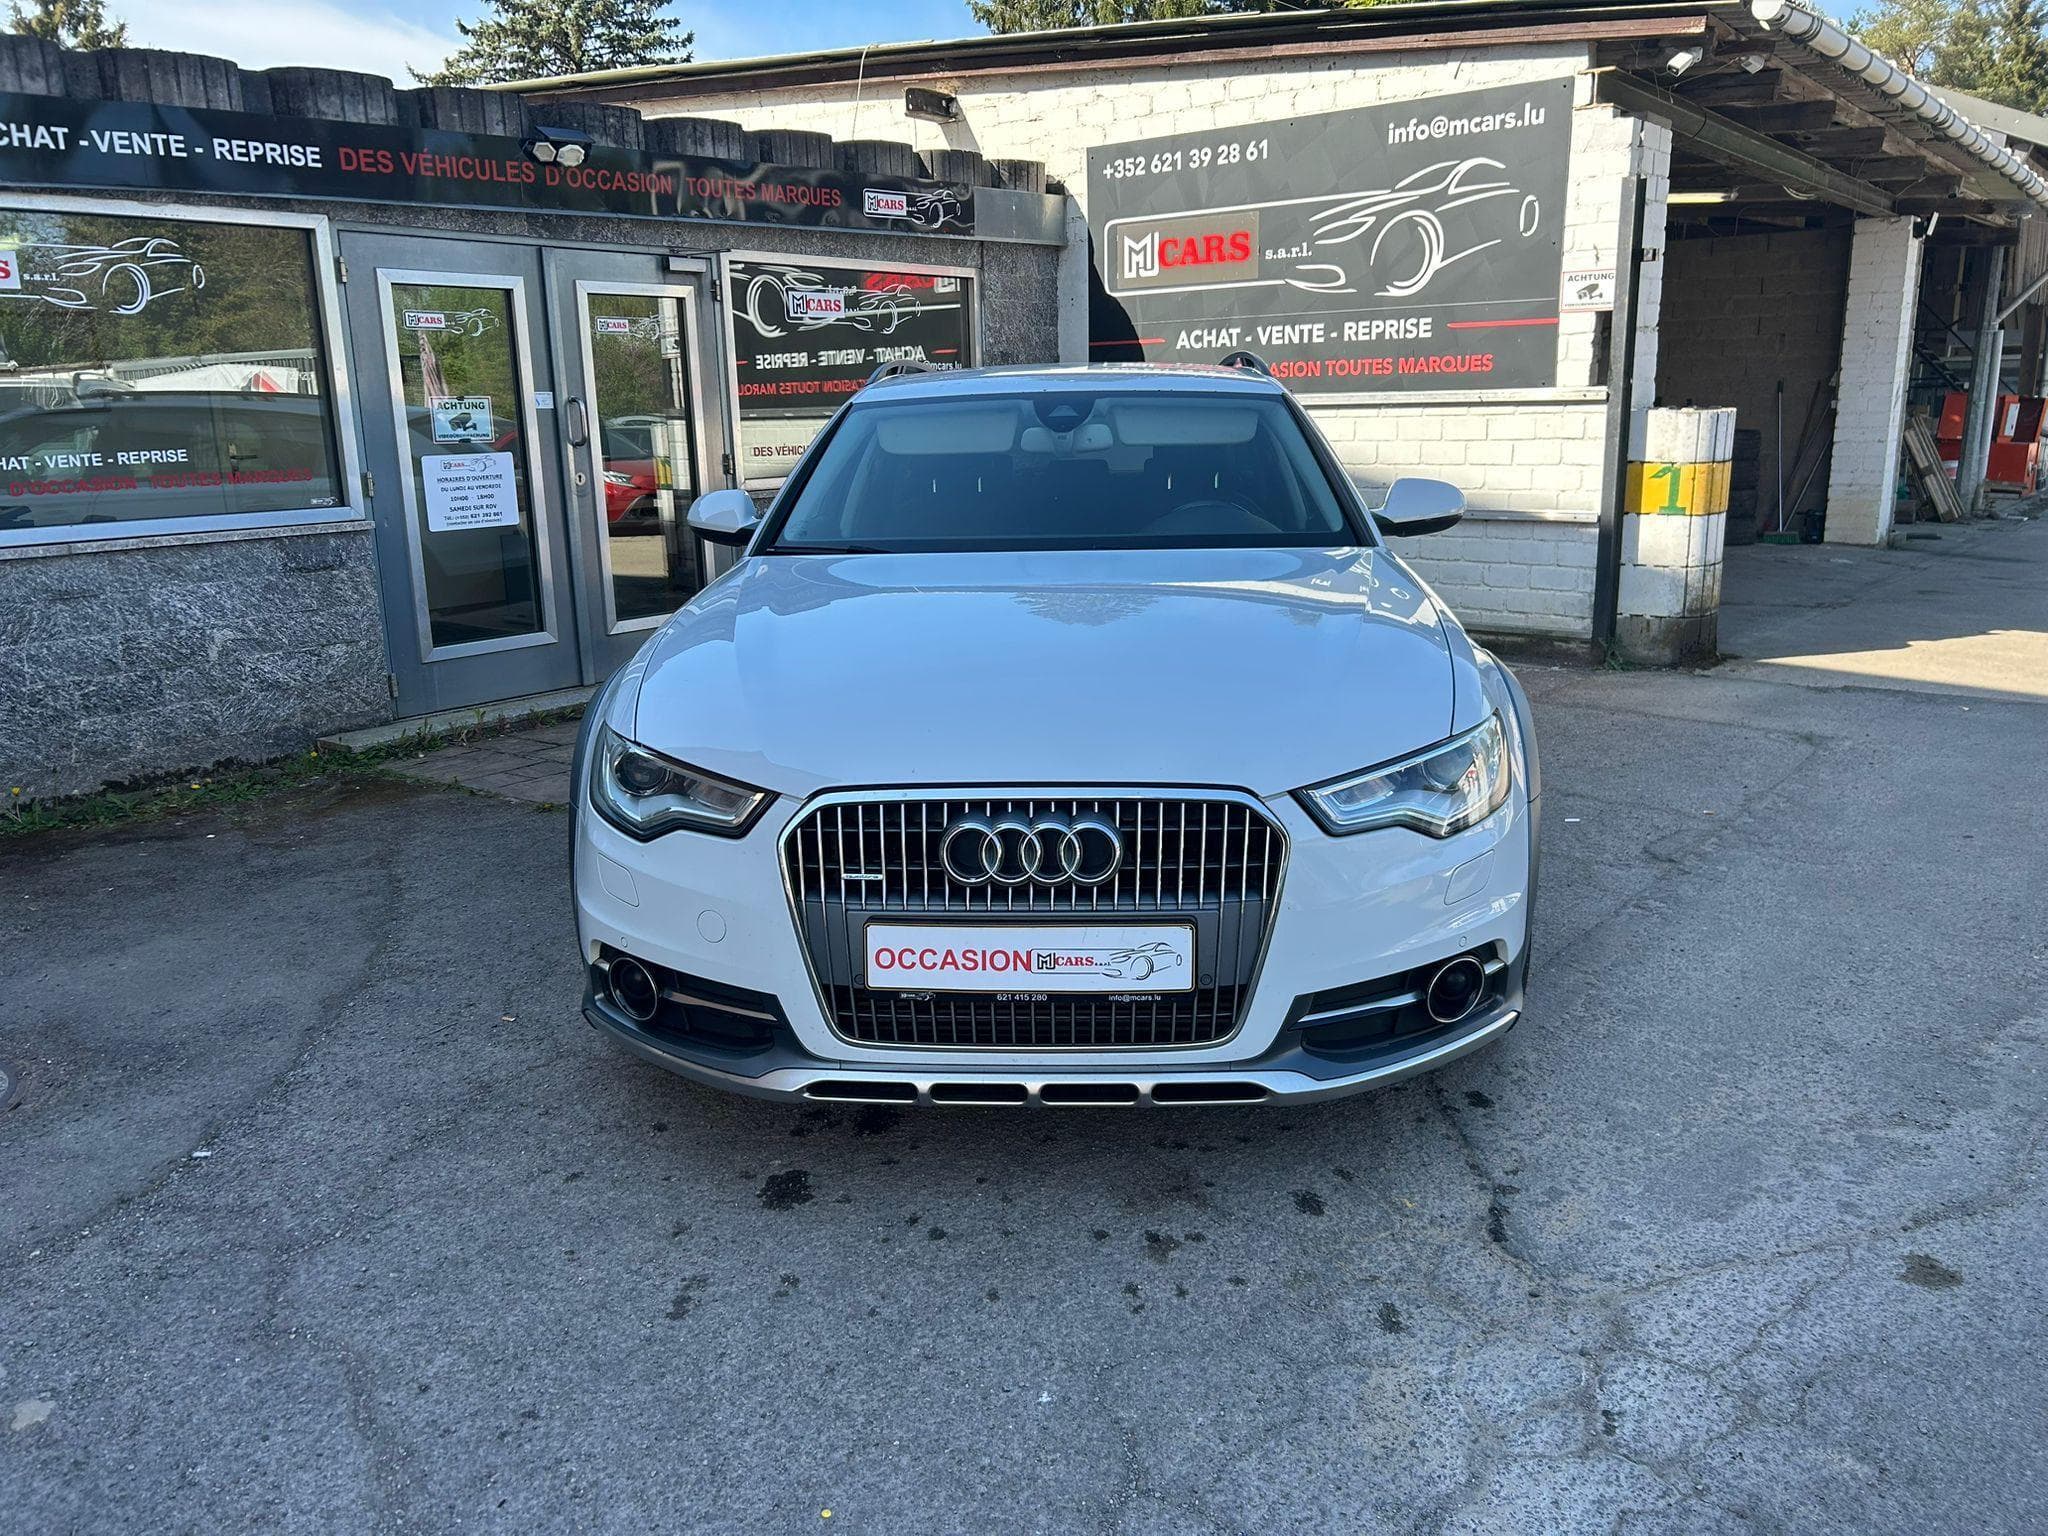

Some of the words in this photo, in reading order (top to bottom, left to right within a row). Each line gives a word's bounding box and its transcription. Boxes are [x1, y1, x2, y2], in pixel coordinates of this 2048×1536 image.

[1388, 103, 1546, 144] info@mcars.lu
[1103, 159, 1146, 180] +352
[1150, 151, 1183, 173] 621
[1189, 148, 1211, 168] 39
[1216, 143, 1240, 164] 28
[1246, 139, 1269, 160] 61
[212, 138, 322, 168] REPRISE
[338, 147, 394, 174] DES
[400, 148, 535, 184] VÉHICULES
[545, 166, 673, 196] D'OCCASION
[686, 176, 756, 200] TOUTES
[760, 182, 842, 207] MARQUES
[878, 198, 904, 211] CARS
[1158, 231, 1251, 269] CARS
[1265, 242, 1312, 261] s.a.r.l.
[1568, 273, 1615, 282] ACHTUNG
[807, 298, 842, 312] CARS
[418, 316, 443, 325] CARS
[1176, 327, 1241, 349] ACHAT
[1257, 324, 1325, 345] VENTE
[1344, 318, 1433, 341] REPRISE
[1325, 358, 1394, 377] TOUTES
[1399, 353, 1494, 374] MARQUES
[437, 402, 486, 411] ACHTUNG
[44, 453, 103, 469] VENTE
[117, 448, 188, 465] REPRISE
[753, 446, 773, 457] DES
[150, 472, 222, 490] TOUTES
[1648, 465, 1687, 515] 1
[874, 947, 1032, 972] OCCASION
[1055, 956, 1095, 966] CARS
[1108, 993, 1162, 1002] info@mcars.lu
